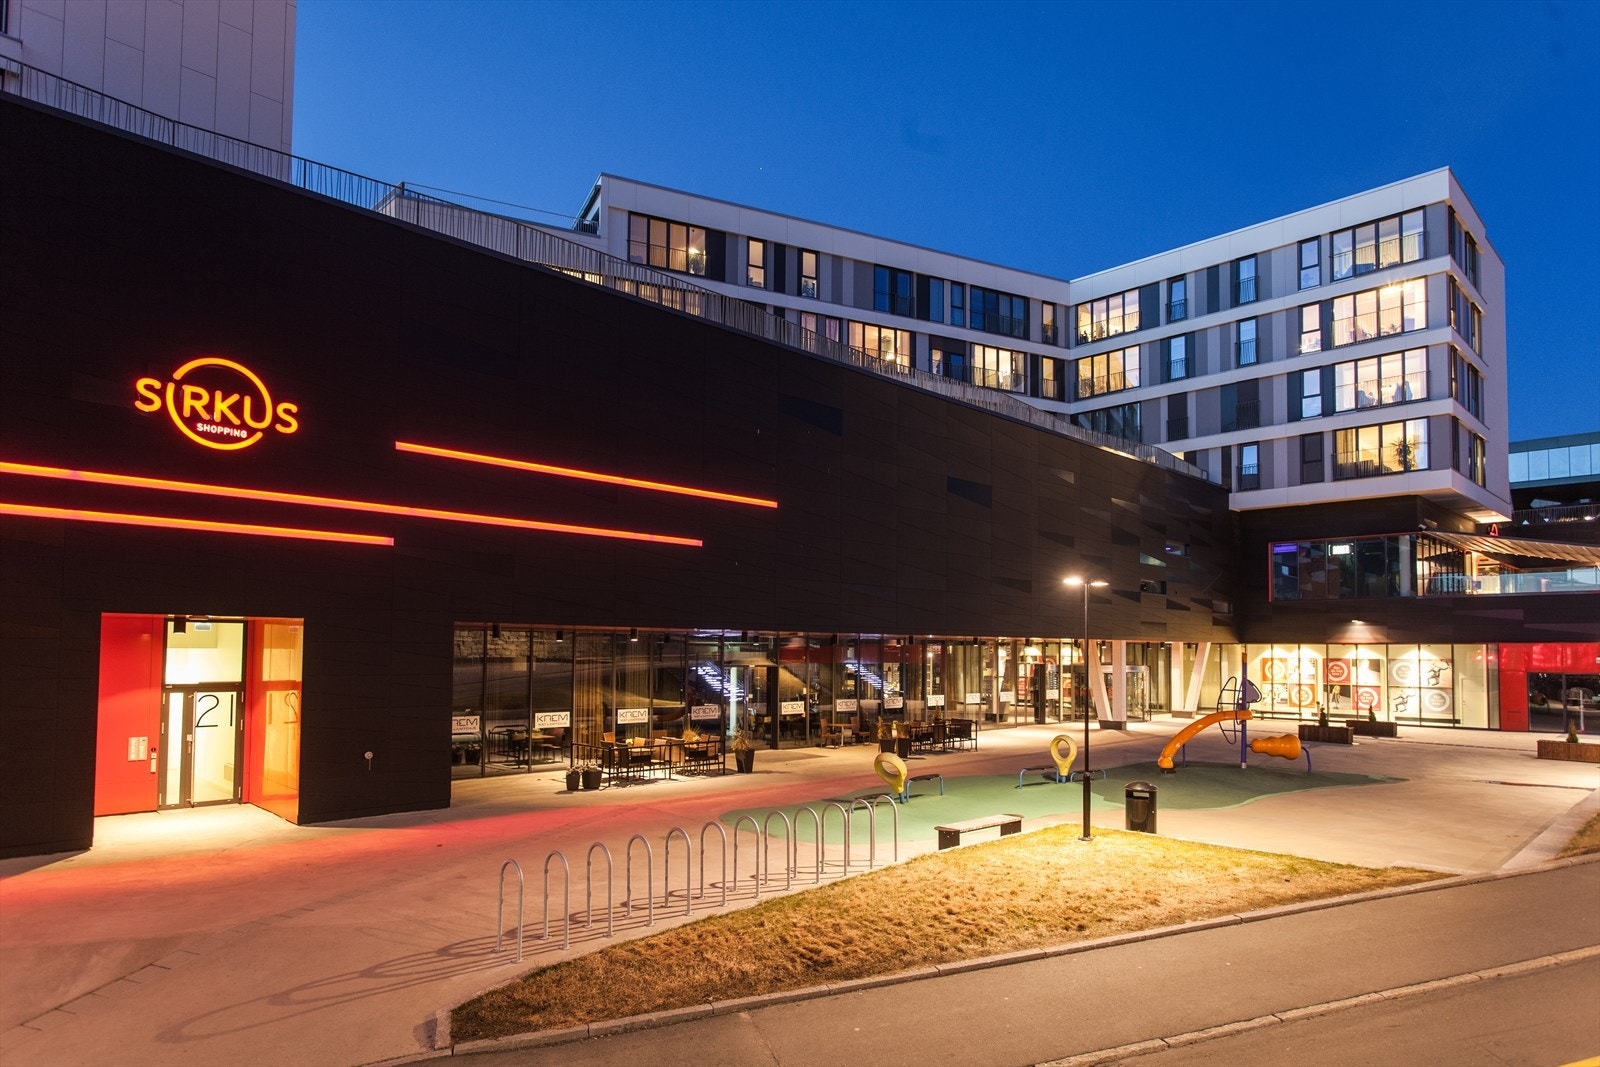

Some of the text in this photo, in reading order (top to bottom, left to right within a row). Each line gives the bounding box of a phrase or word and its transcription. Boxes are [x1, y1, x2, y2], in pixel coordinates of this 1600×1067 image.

[134, 376, 299, 434] SIRKUS
[196, 422, 248, 439] SHOPPING
[195, 693, 234, 728] 21
[619, 710, 647, 719] KREM
[692, 707, 717, 715] KREM
[452, 718, 478, 727] REM
[536, 713, 569, 723] KREM
